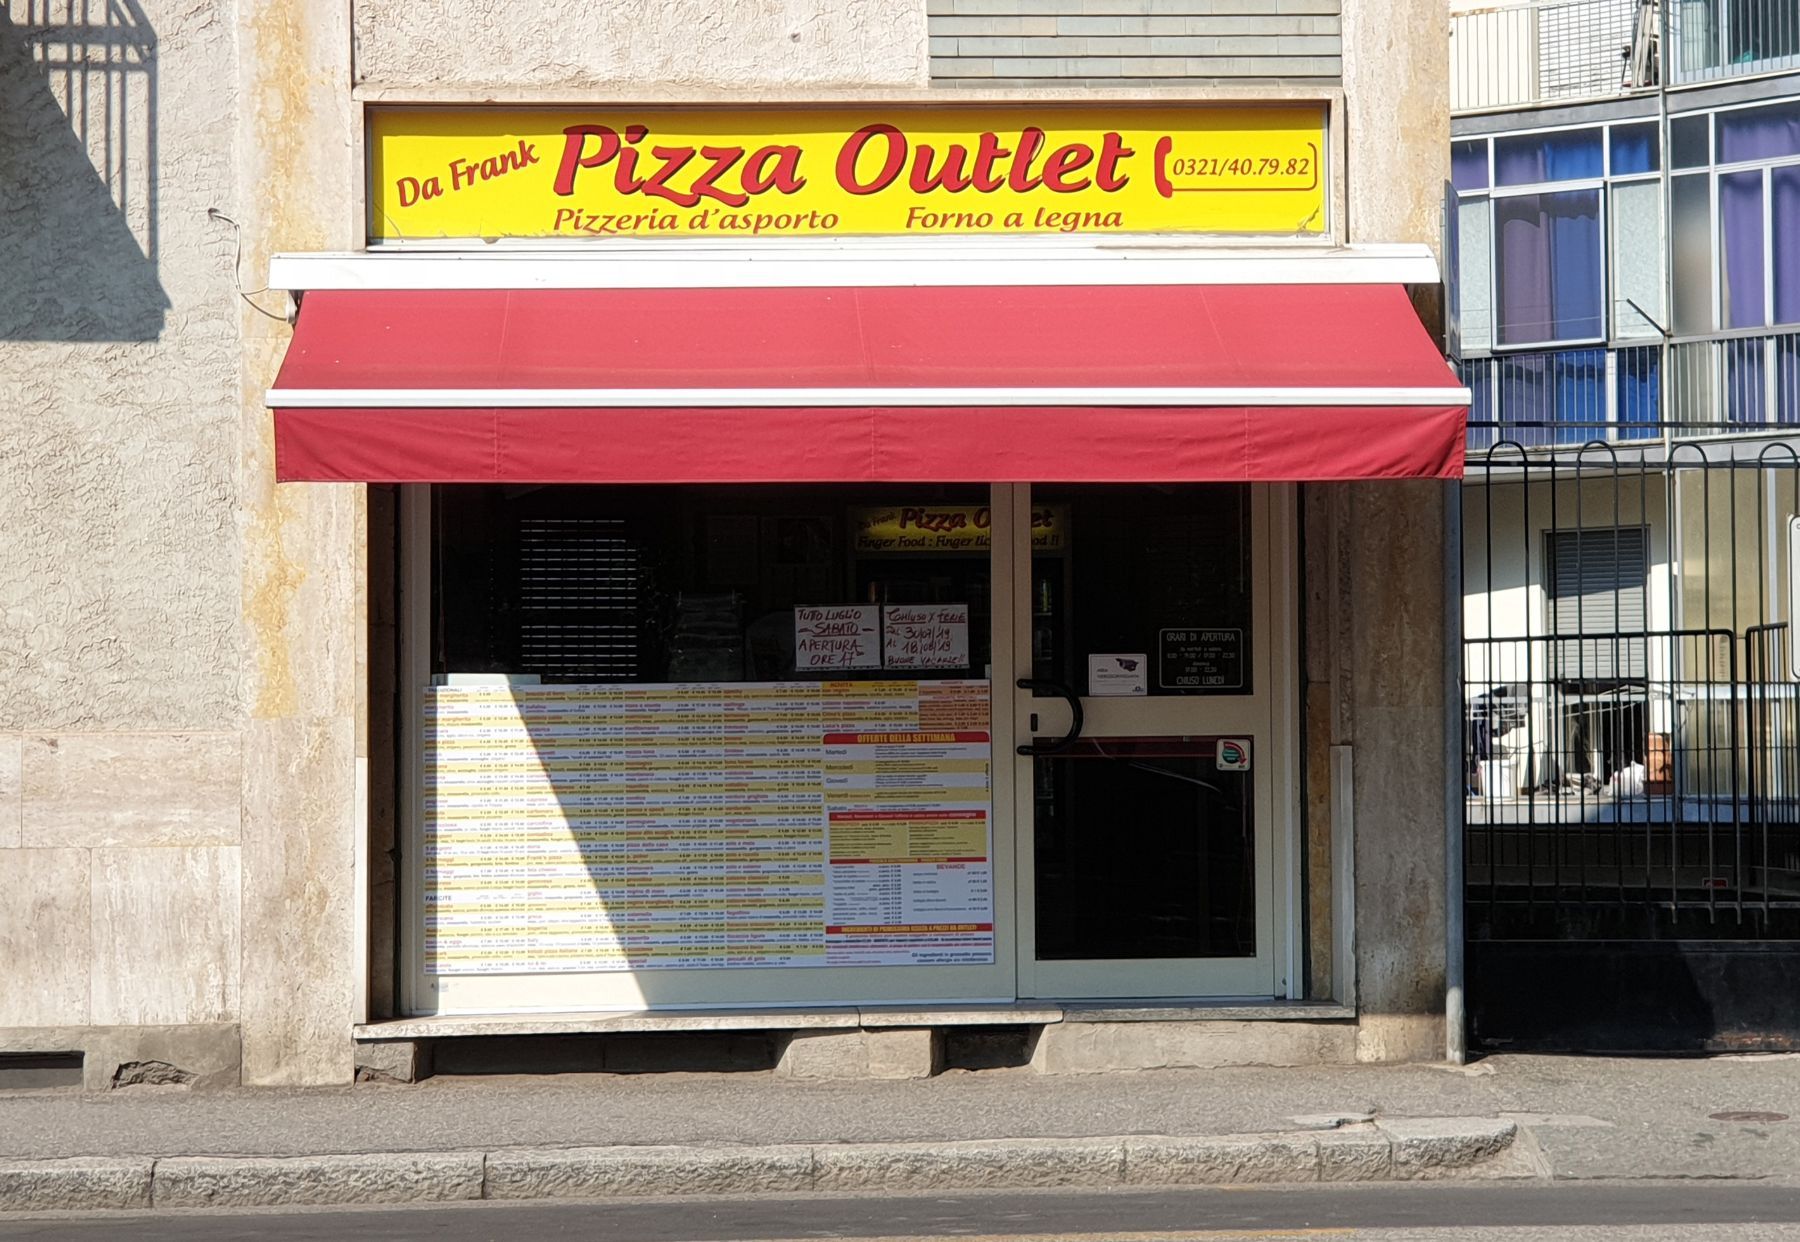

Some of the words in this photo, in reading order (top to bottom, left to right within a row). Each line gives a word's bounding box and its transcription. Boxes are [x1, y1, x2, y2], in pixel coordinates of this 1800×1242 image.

[395, 177, 443, 208] Da
[449, 140, 540, 191] Frank
[553, 124, 807, 208] Pizza
[835, 123, 1135, 195] Outlet
[1172, 156, 1309, 178] 0321/40.79.82
[554, 208, 679, 234] Pizzeria
[689, 208, 838, 234] d'asporto
[906, 206, 993, 229] Forno
[1004, 212, 1025, 228] a
[1034, 206, 1123, 232] legna
[899, 508, 967, 532] Pizza
[858, 535, 895, 549] Finger
[898, 535, 926, 547] Food
[936, 535, 974, 548] Finger
[814, 621, 859, 635] SABATO
[798, 639, 864, 653] APERTURA
[810, 654, 835, 665] ORE
[857, 734, 889, 743] OFFERTE
[889, 734, 912, 743] DELLA
[912, 733, 956, 743] SETTIMANA
